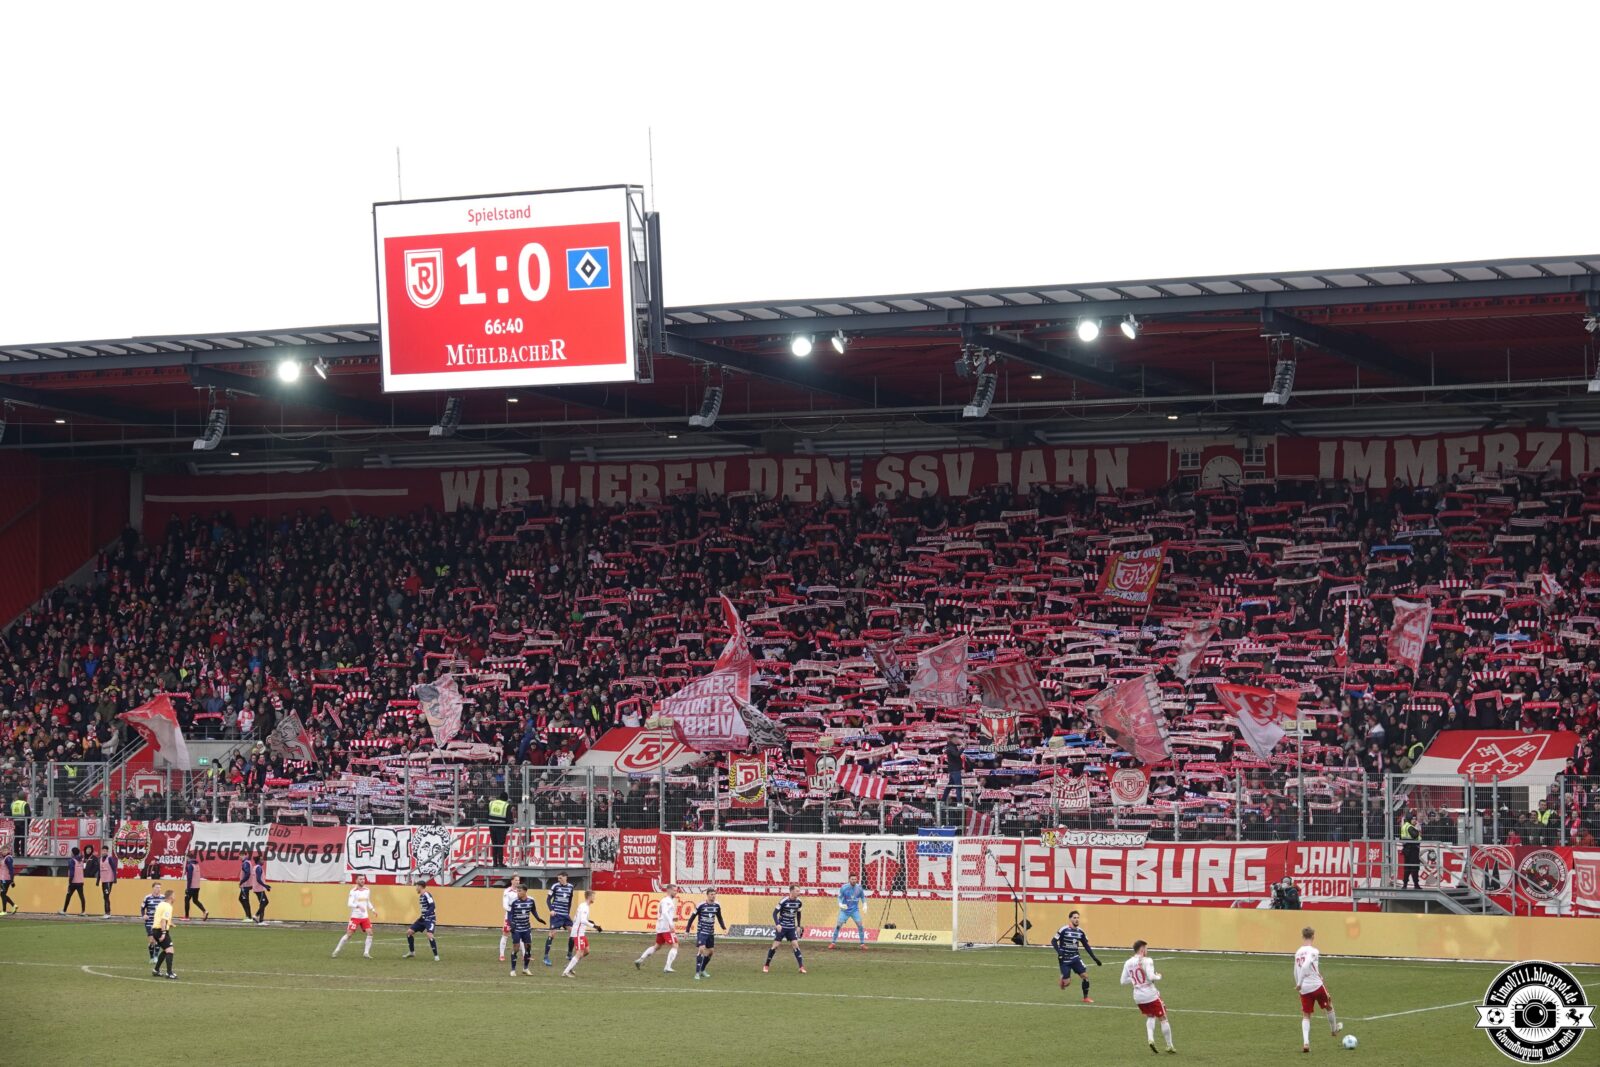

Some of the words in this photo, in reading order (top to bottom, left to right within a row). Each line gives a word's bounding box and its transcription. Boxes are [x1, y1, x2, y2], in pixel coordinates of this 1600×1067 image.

[468, 205, 531, 225] Spielstand
[456, 242, 551, 305] 1:0
[484, 317, 524, 335] 66:40
[445, 338, 567, 367] MÜHLBACHER
[440, 467, 530, 512] WIR
[550, 460, 727, 508] LIEBEN
[748, 457, 846, 502] DEN
[875, 452, 974, 500] SSV
[997, 448, 1129, 497] JAHN
[248, 825, 291, 838] Fanclub
[623, 835, 657, 844] SEKTION
[1062, 832, 1087, 845] RED
[195, 840, 318, 865] REGENSBURG
[321, 842, 343, 864] 81
[623, 845, 657, 854] STADION
[623, 855, 657, 865] VERBOT
[675, 838, 851, 884] ULTRAS
[919, 842, 1268, 895] REGENSBURG
[1294, 847, 1360, 875] JAHN
[1293, 879, 1359, 897] STADION
[809, 928, 869, 941] Photvoltak
[894, 931, 938, 943] Autarkie
